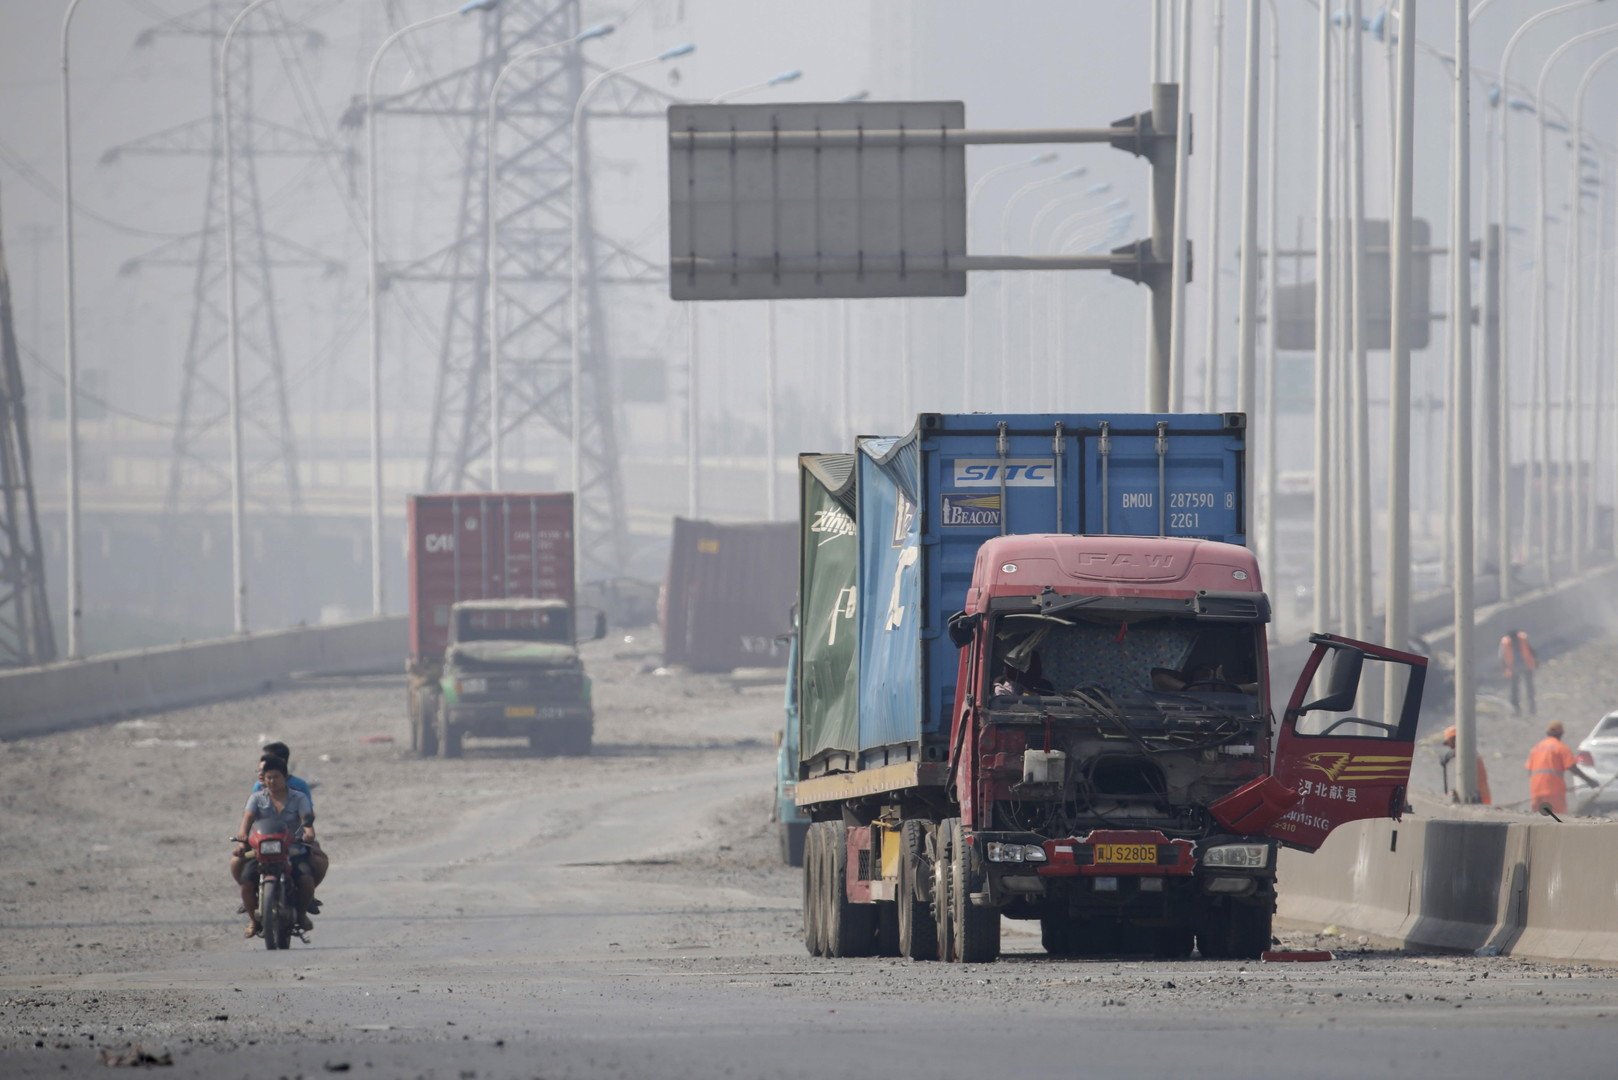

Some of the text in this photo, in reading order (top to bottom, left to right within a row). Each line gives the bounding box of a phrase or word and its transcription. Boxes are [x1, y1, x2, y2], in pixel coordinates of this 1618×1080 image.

[957, 465, 1053, 480] SITC
[1122, 493, 1153, 508] BMOU
[1170, 493, 1214, 508] 287590
[951, 506, 1000, 524] BEACON
[1170, 513, 1199, 528] 22G1
[1078, 553, 1174, 568] FAW
